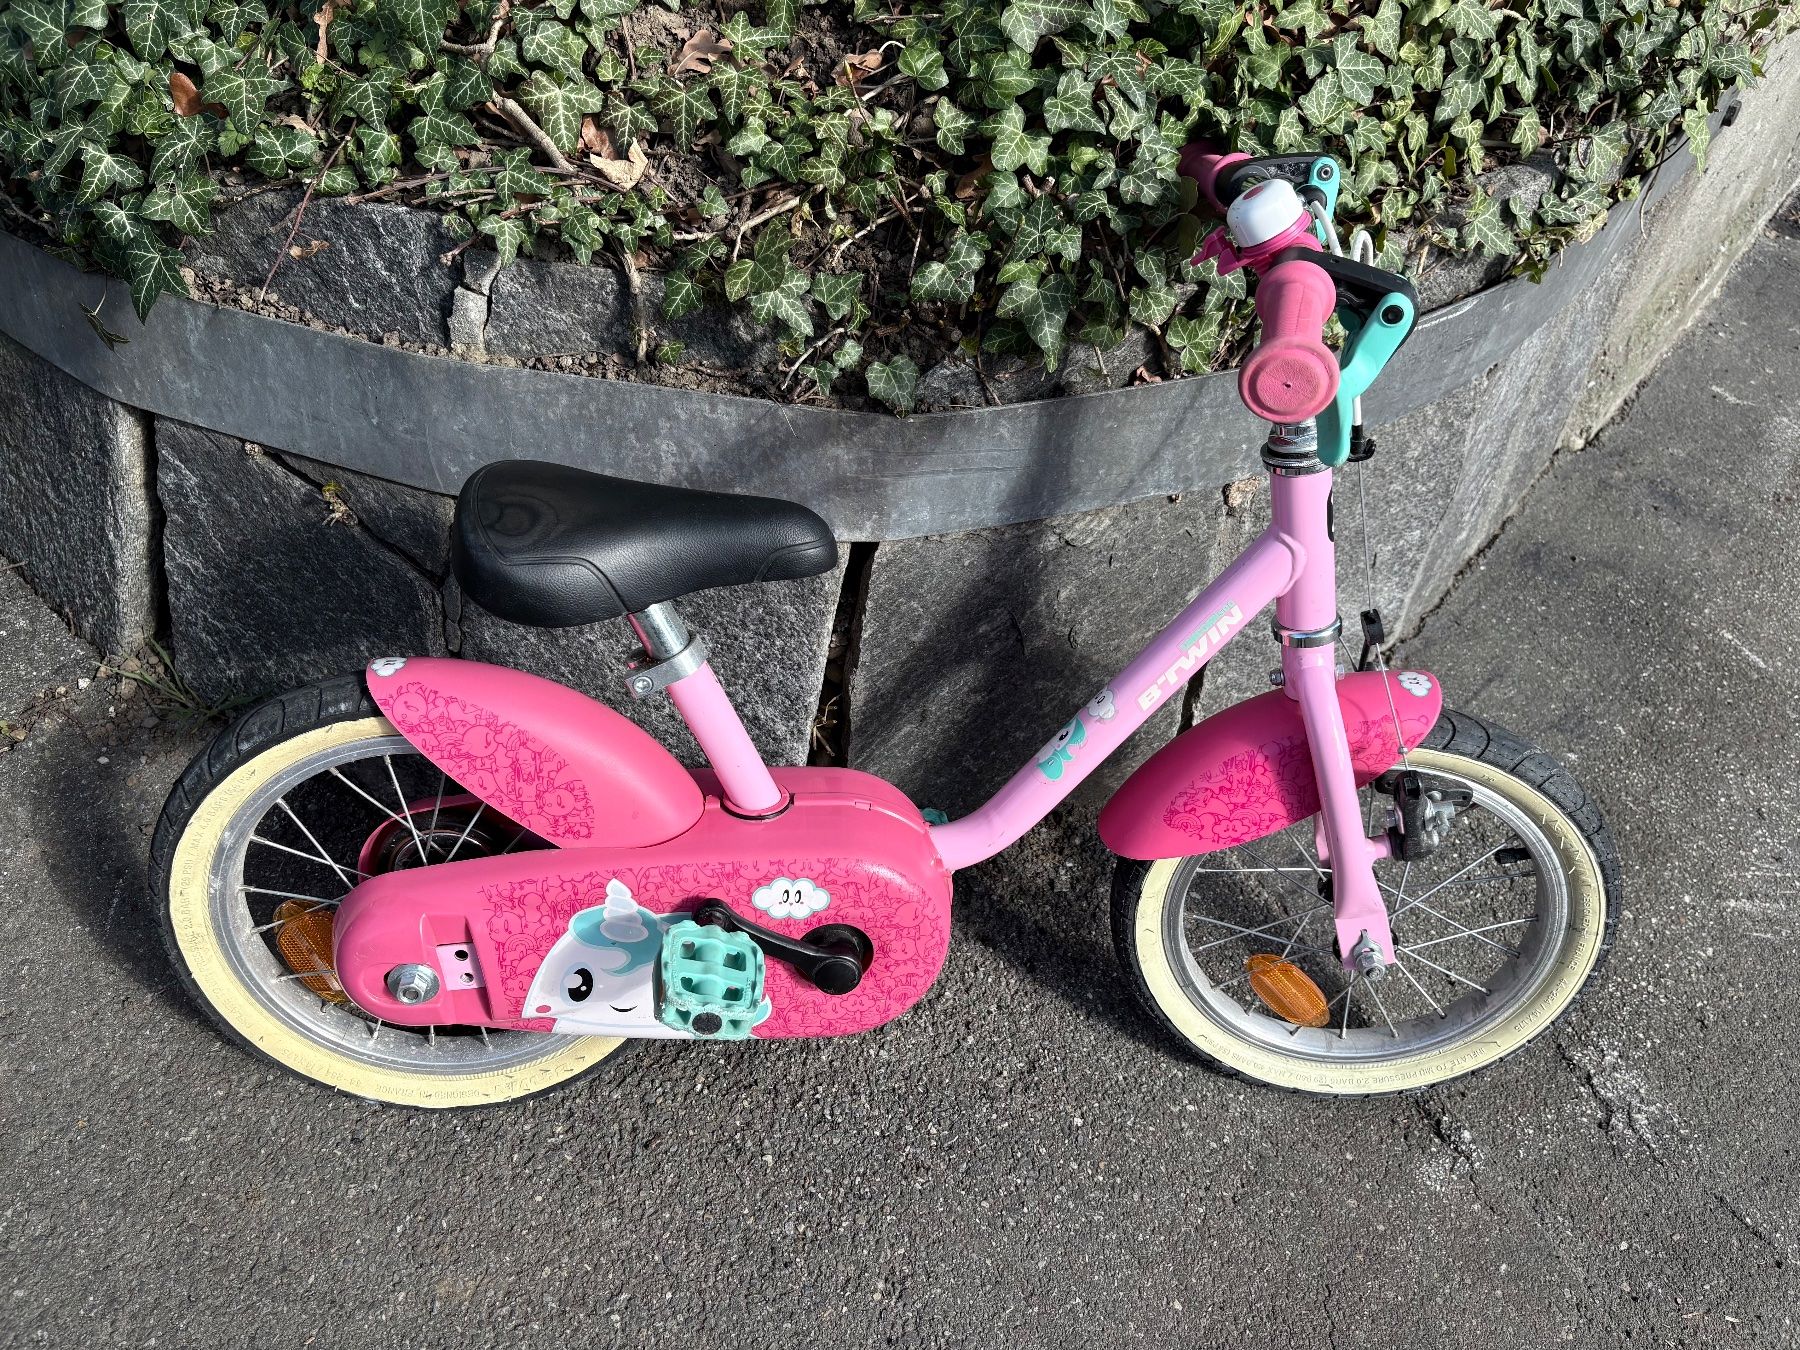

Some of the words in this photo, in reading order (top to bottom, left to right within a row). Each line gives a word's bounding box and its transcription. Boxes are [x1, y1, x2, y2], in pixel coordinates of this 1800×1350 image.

[1138, 605, 1244, 711] B'TWIN
[180, 916, 194, 929] 2.0
[188, 830, 205, 850] MAX
[1566, 941, 1587, 971] FRANCE
[1542, 977, 1570, 1005] 44-254
[1434, 1062, 1448, 1072] TO
[1447, 1046, 1487, 1068] INFLATE
[1371, 1070, 1418, 1083] PRESSURE
